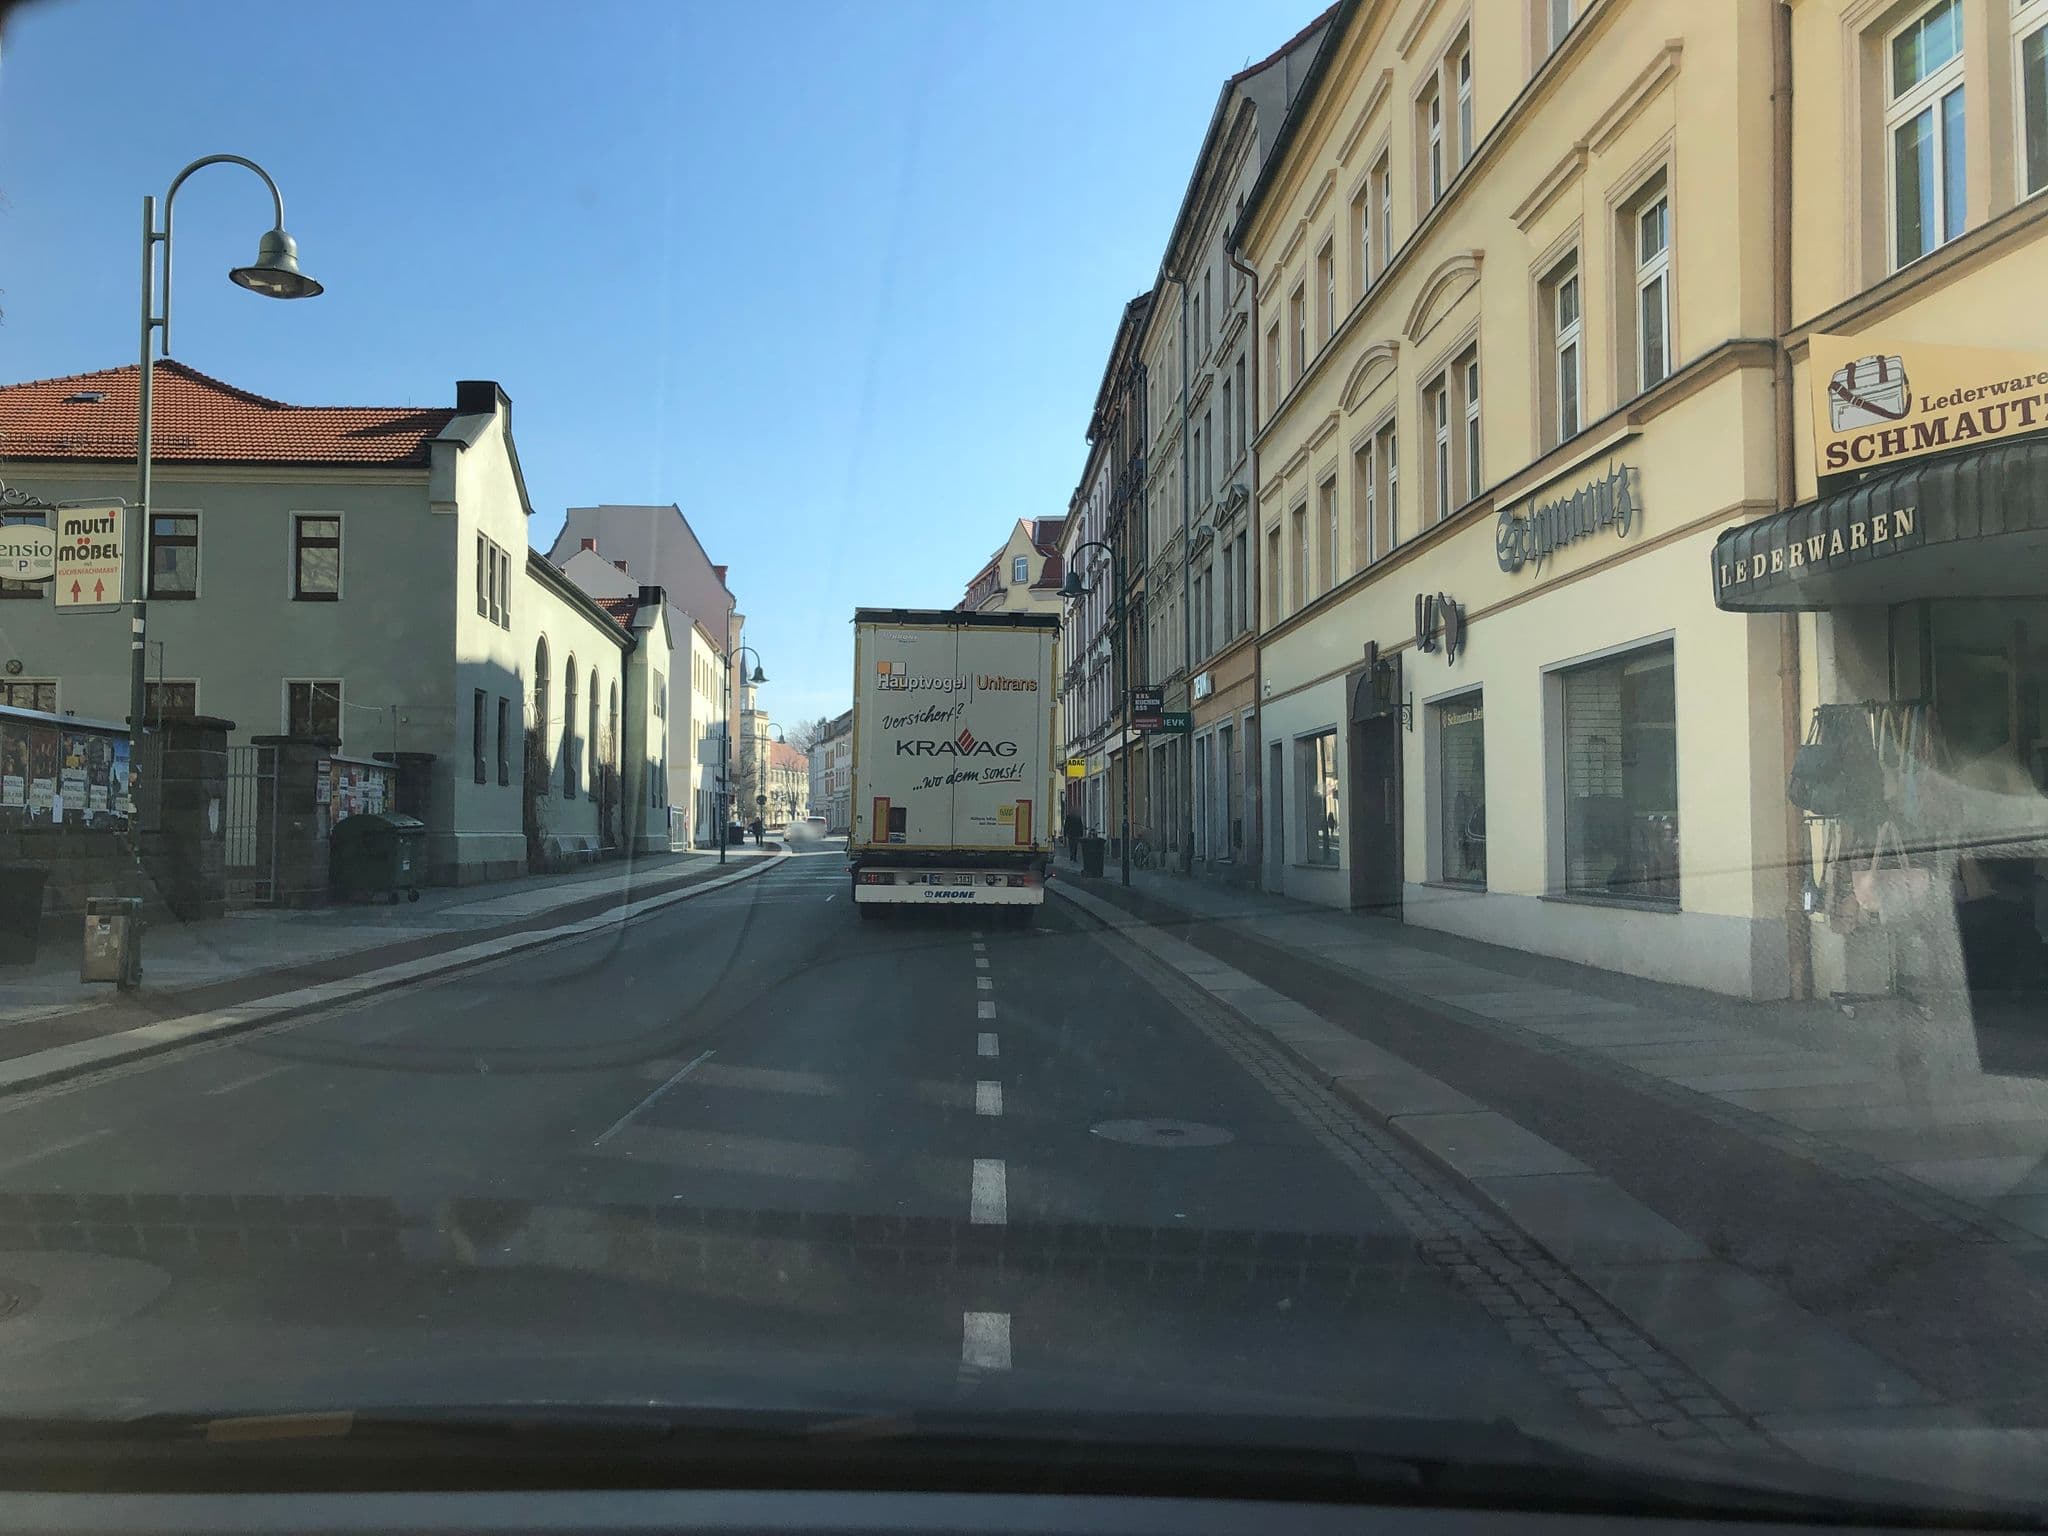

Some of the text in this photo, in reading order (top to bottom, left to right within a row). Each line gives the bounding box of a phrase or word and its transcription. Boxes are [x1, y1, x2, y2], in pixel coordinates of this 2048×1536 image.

[1826, 391, 2048, 469] SCHMAUT
[64, 510, 116, 536] MULTI
[59, 537, 119, 562] MÖBEL
[1721, 507, 1916, 588] LEDERWAREN
[877, 673, 1038, 693] Hauptvogel Unitrans
[882, 702, 965, 730] versichert?
[896, 740, 1018, 757] KRAVAG
[981, 762, 1026, 780] sonst!
[934, 890, 976, 899] KRONE
